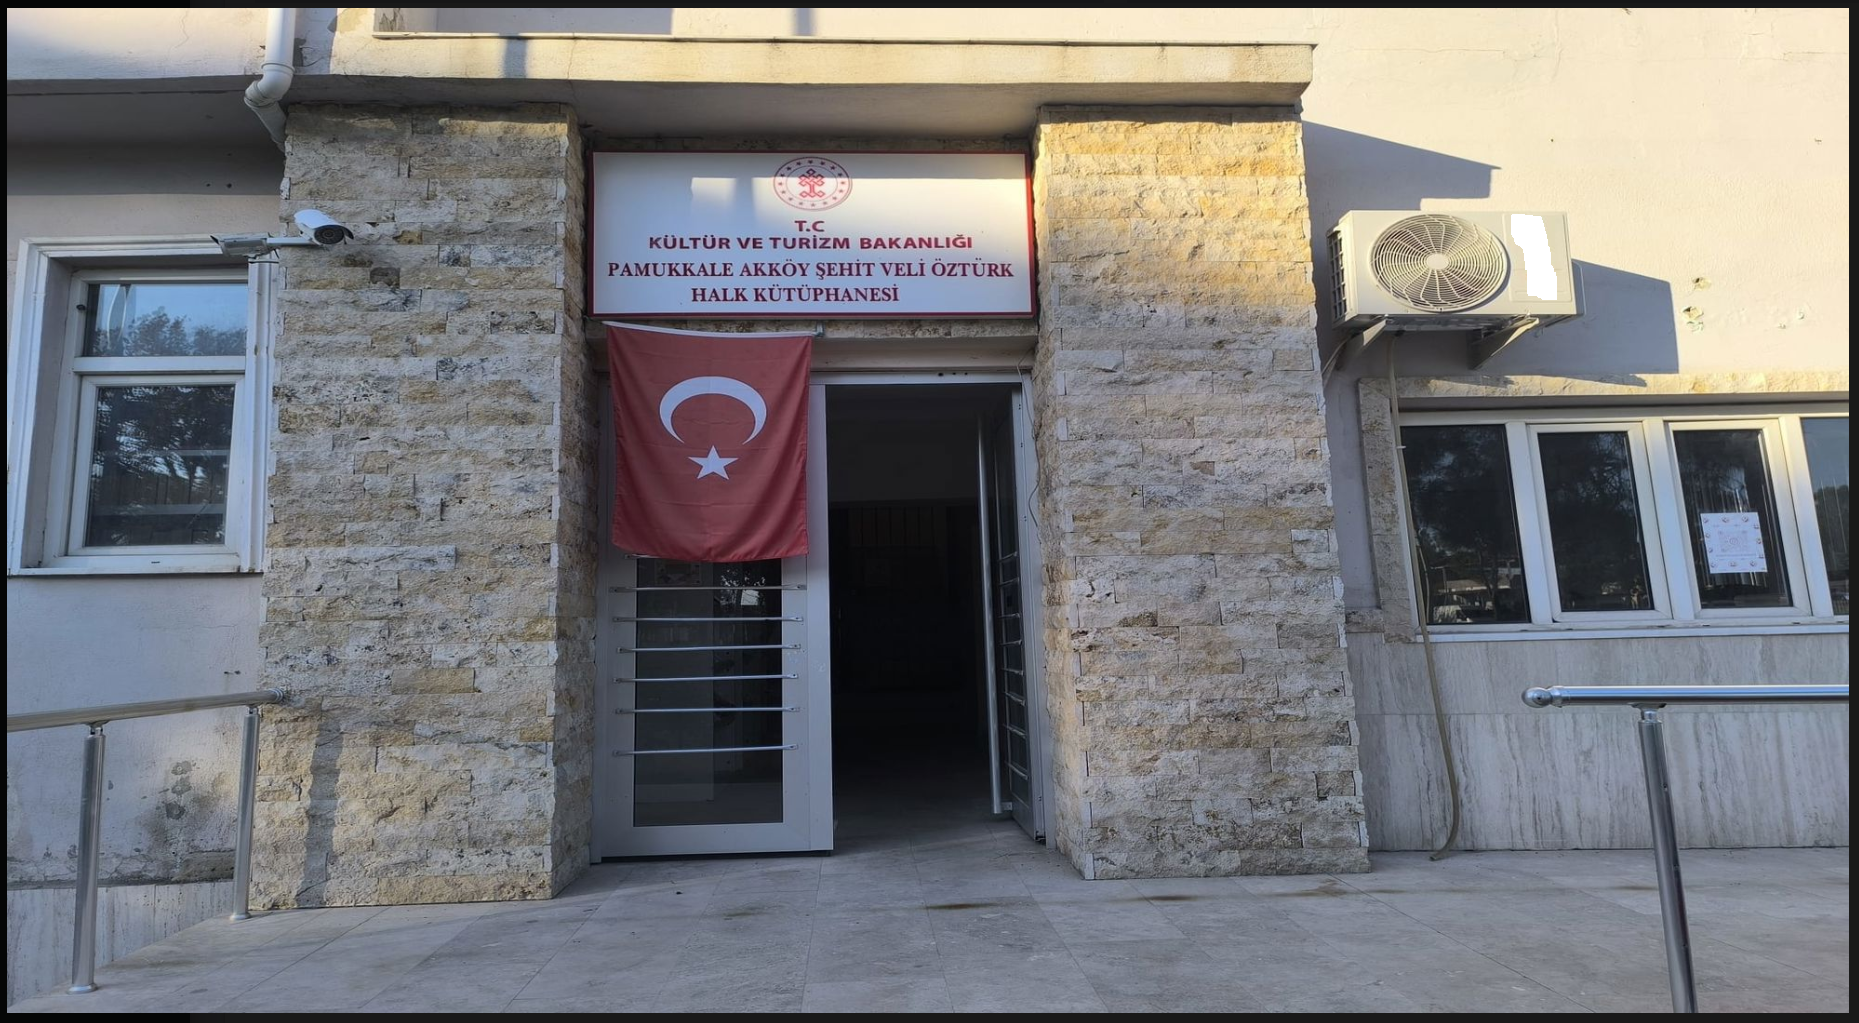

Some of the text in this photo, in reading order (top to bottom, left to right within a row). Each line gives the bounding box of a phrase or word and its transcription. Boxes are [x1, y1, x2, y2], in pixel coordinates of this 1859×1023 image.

[794, 220, 825, 232] T.C
[649, 234, 973, 249] KÜLTÜR VE TURİZM BAKANLIĞI
[607, 257, 1014, 280] PAMUKKALE AKKÖY ŞEHİT VELİ ÖZTÜRK
[691, 283, 900, 302] HALK KÜTÜPHANESİ
